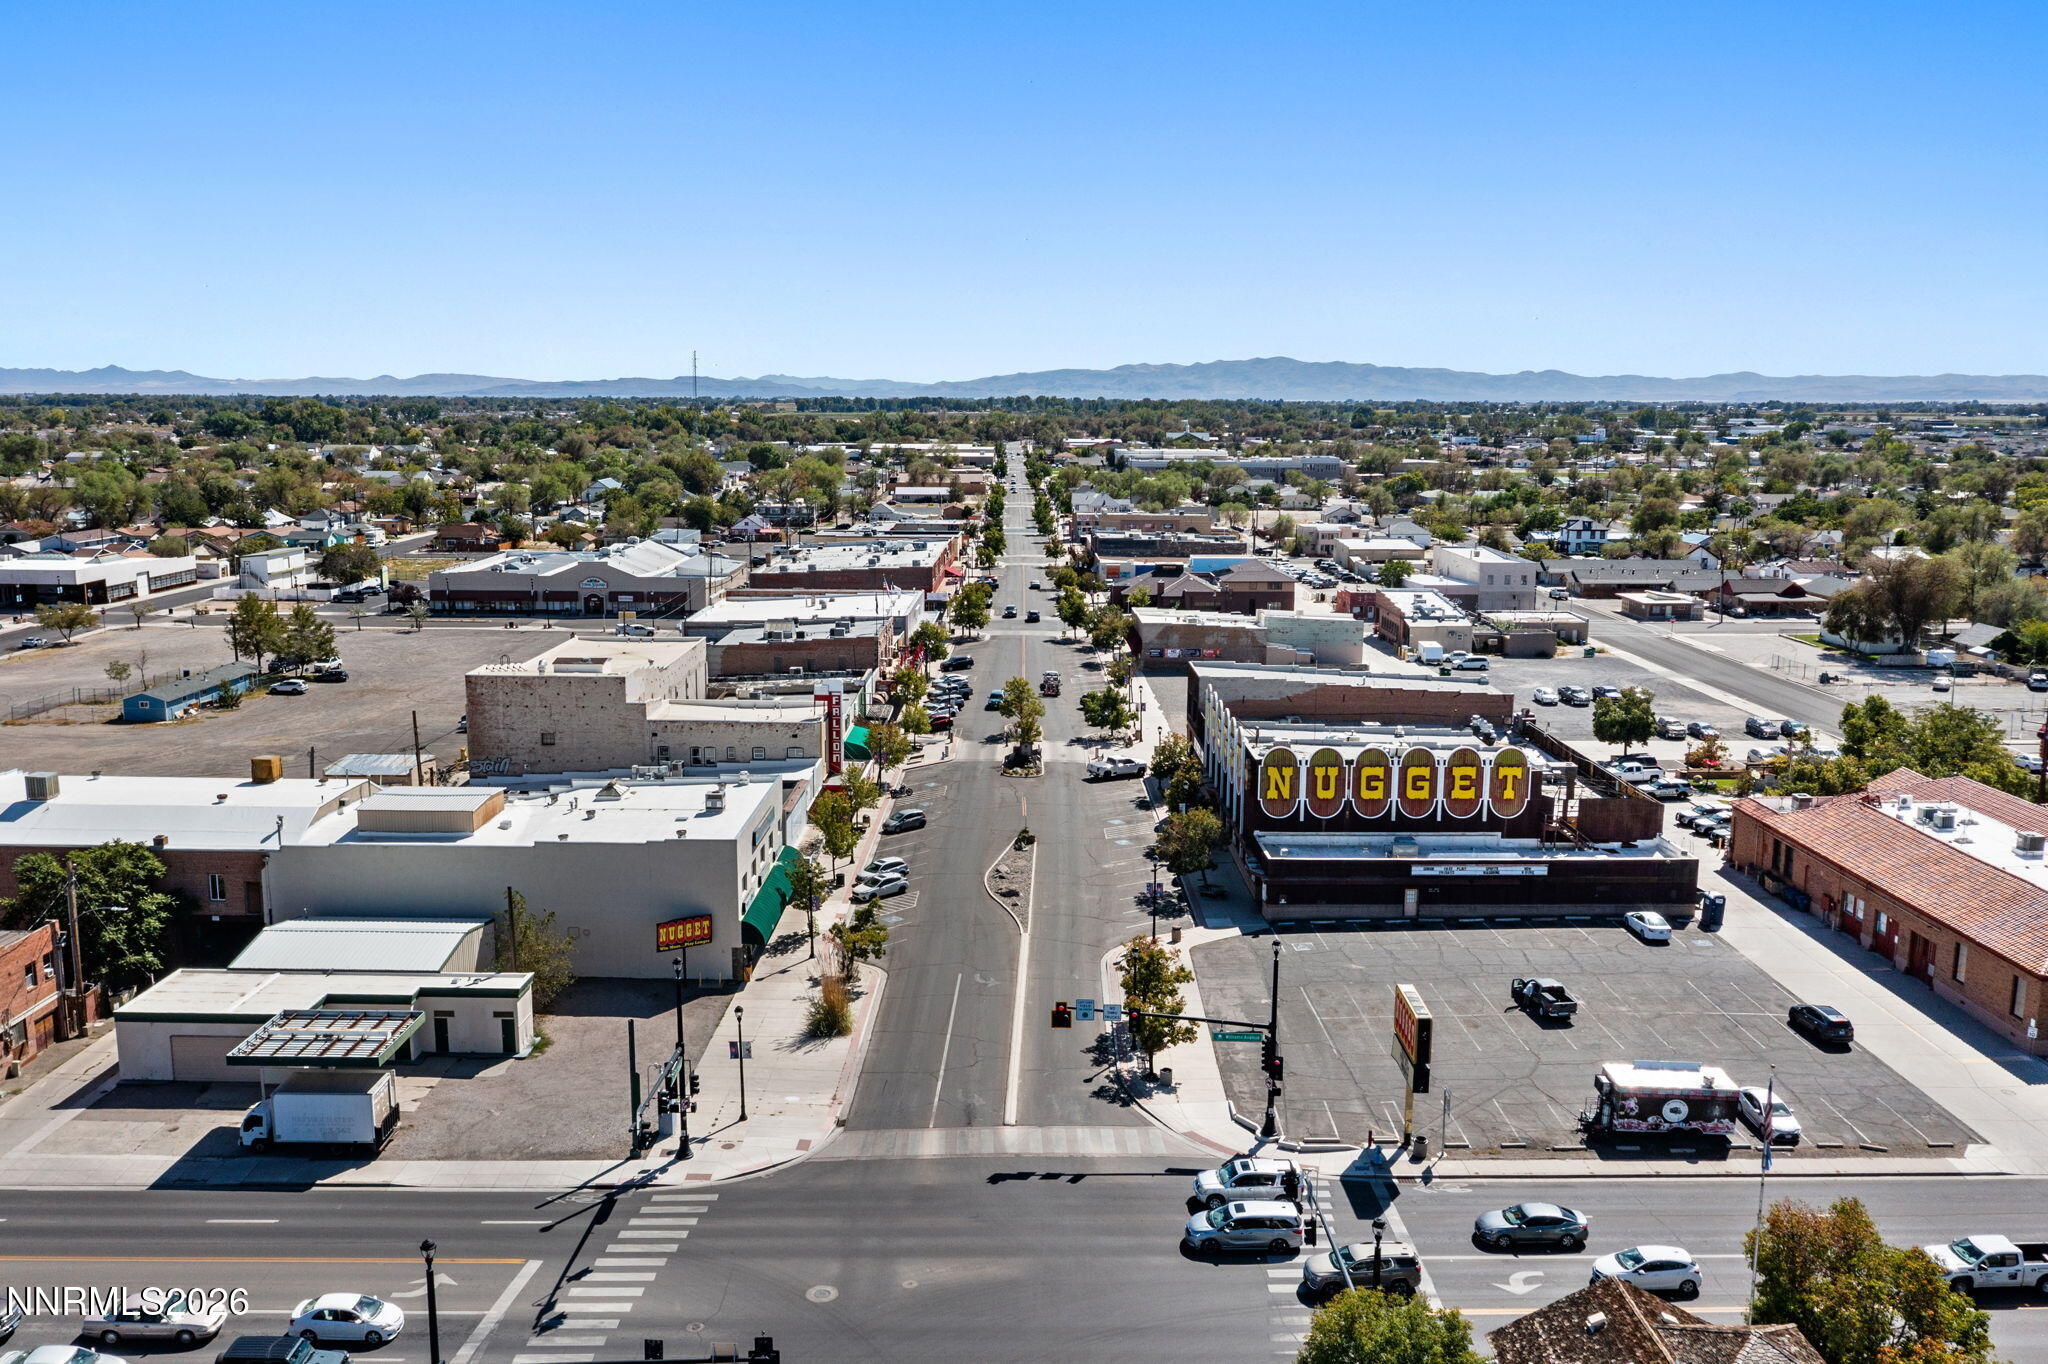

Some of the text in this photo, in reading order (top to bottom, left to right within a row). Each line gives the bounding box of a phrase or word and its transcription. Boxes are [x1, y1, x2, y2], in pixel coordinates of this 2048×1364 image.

[832, 696, 841, 762] FALLON
[1266, 765, 1523, 800] NUGGET
[660, 921, 709, 942] NUGGET
